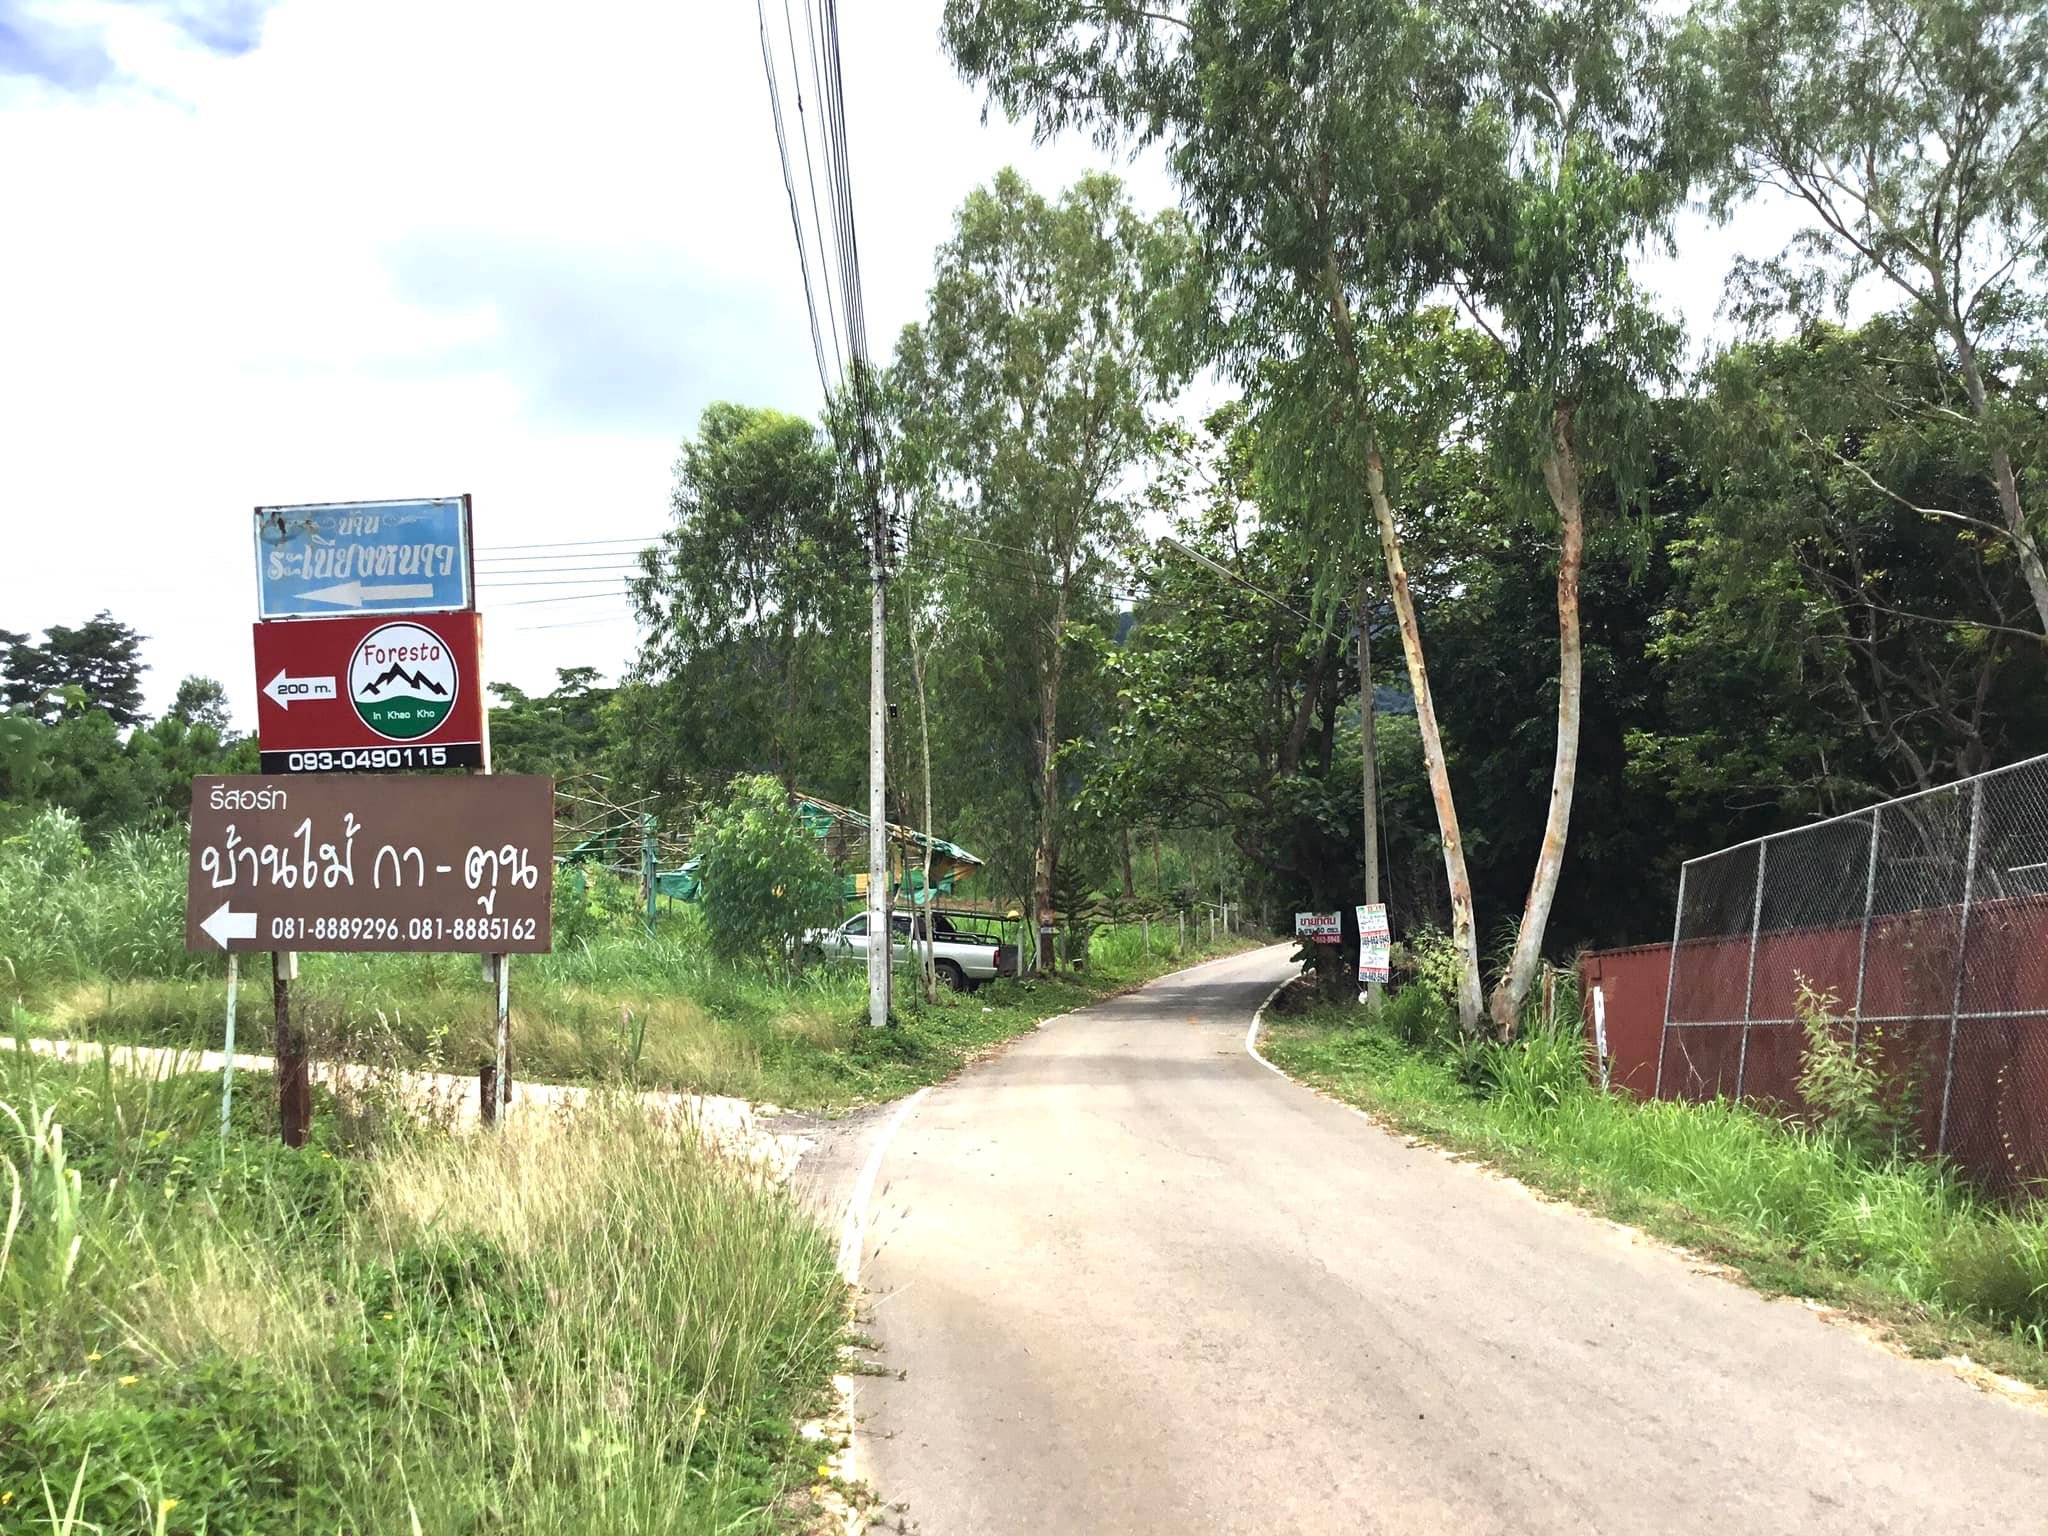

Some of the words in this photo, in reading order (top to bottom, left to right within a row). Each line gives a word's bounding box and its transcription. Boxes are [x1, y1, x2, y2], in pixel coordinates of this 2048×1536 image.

[364, 642, 440, 666] Foresta
[277, 684, 309, 695] 200
[373, 711, 382, 720] In
[387, 710, 411, 720] Khao
[416, 708, 436, 719] Kho
[288, 747, 447, 772] 093-0490115
[210, 784, 287, 810] รีสอร์ท
[200, 812, 361, 889] บ้านไม้
[373, 845, 425, 889] กา
[464, 844, 538, 915] ตูน
